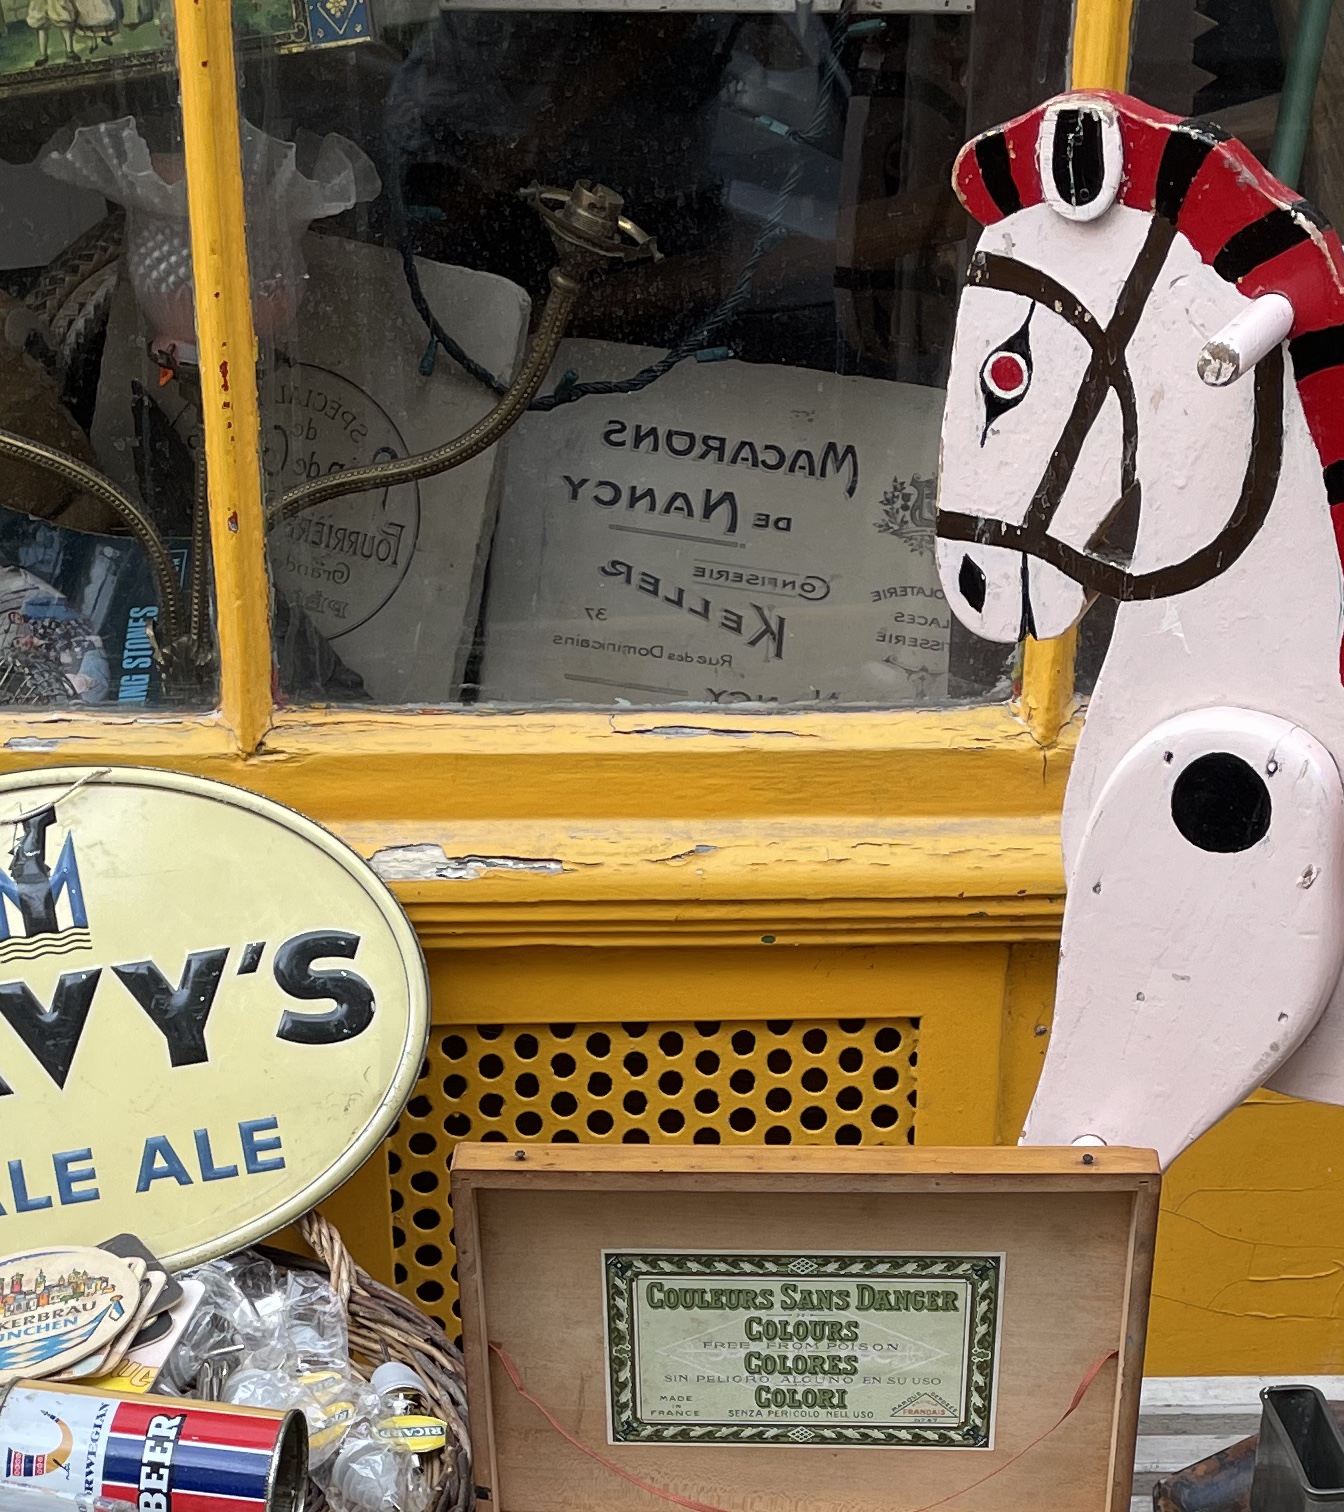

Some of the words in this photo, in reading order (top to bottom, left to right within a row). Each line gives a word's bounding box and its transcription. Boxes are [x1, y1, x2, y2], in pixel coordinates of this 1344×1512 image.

[122, 605, 160, 669] STONES
[134, 1115, 287, 1194] ALE
[646, 1281, 774, 1312] COULEURS
[780, 1282, 852, 1312] SANS
[855, 1283, 960, 1313] DANGER
[744, 1316, 860, 1342] COLOURS
[703, 1341, 751, 1350] FREE
[766, 1341, 820, 1351] FROM
[826, 1342, 900, 1351] POISON
[743, 1351, 859, 1376] COLORES
[664, 1374, 688, 1383] SIN
[696, 1375, 771, 1385] PELIGRO
[780, 1376, 854, 1385] ALGUNO
[862, 1376, 883, 1386] EN
[887, 1376, 908, 1386] SU
[912, 1377, 943, 1387] USO
[659, 1394, 693, 1403] MADE
[754, 1385, 848, 1411] COLORI
[650, 1409, 700, 1417] FRANCE
[728, 1409, 763, 1419] SENZA
[767, 1409, 821, 1419] PERICOLO
[380, 1426, 444, 1438] RICARD
